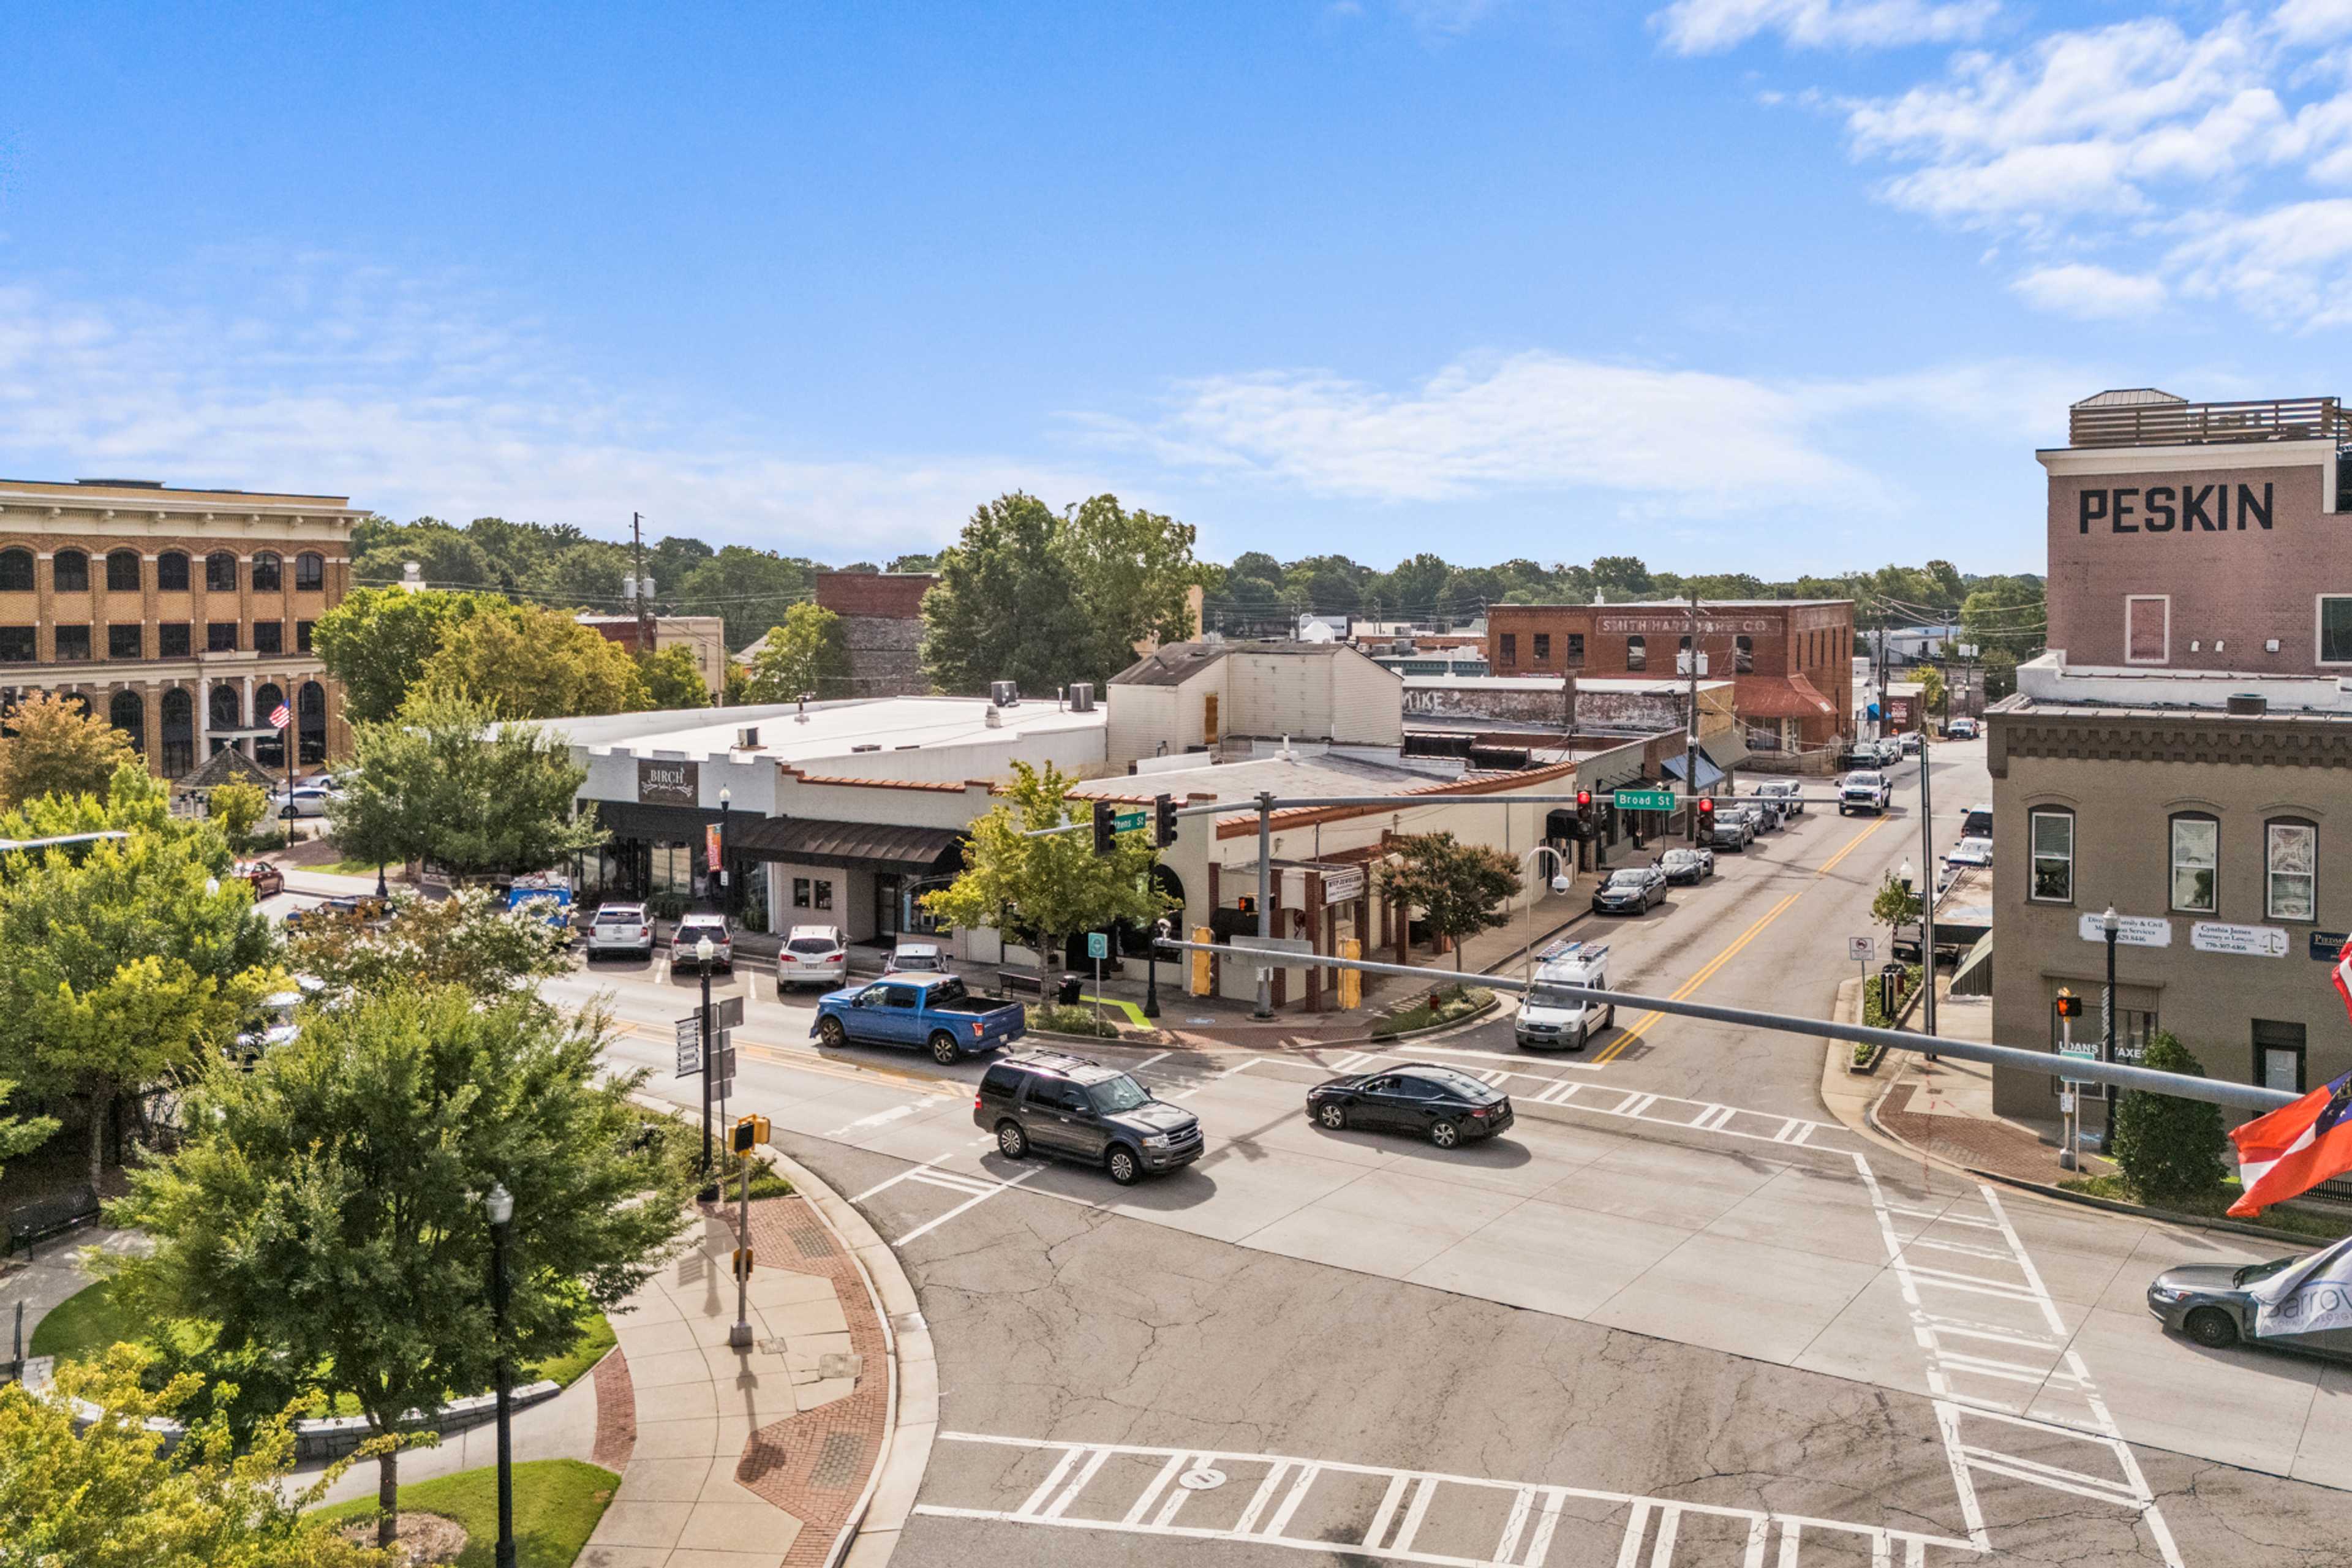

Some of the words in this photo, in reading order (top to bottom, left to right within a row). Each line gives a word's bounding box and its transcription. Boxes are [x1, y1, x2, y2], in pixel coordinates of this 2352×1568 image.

[2079, 482, 2273, 534] PESKIN
[1603, 620, 1646, 631] SMITH
[651, 769, 683, 784] BIRCH
[1619, 794, 1651, 805] Broad
[1658, 796, 1670, 805] St
[1110, 819, 1132, 829] thens
[1137, 815, 1144, 826] St
[2201, 925, 2228, 933] Cynthia
[2198, 932, 2223, 941] Attorney
[2315, 935, 2347, 945] PIEDMO
[2267, 1289, 2352, 1319] arro
